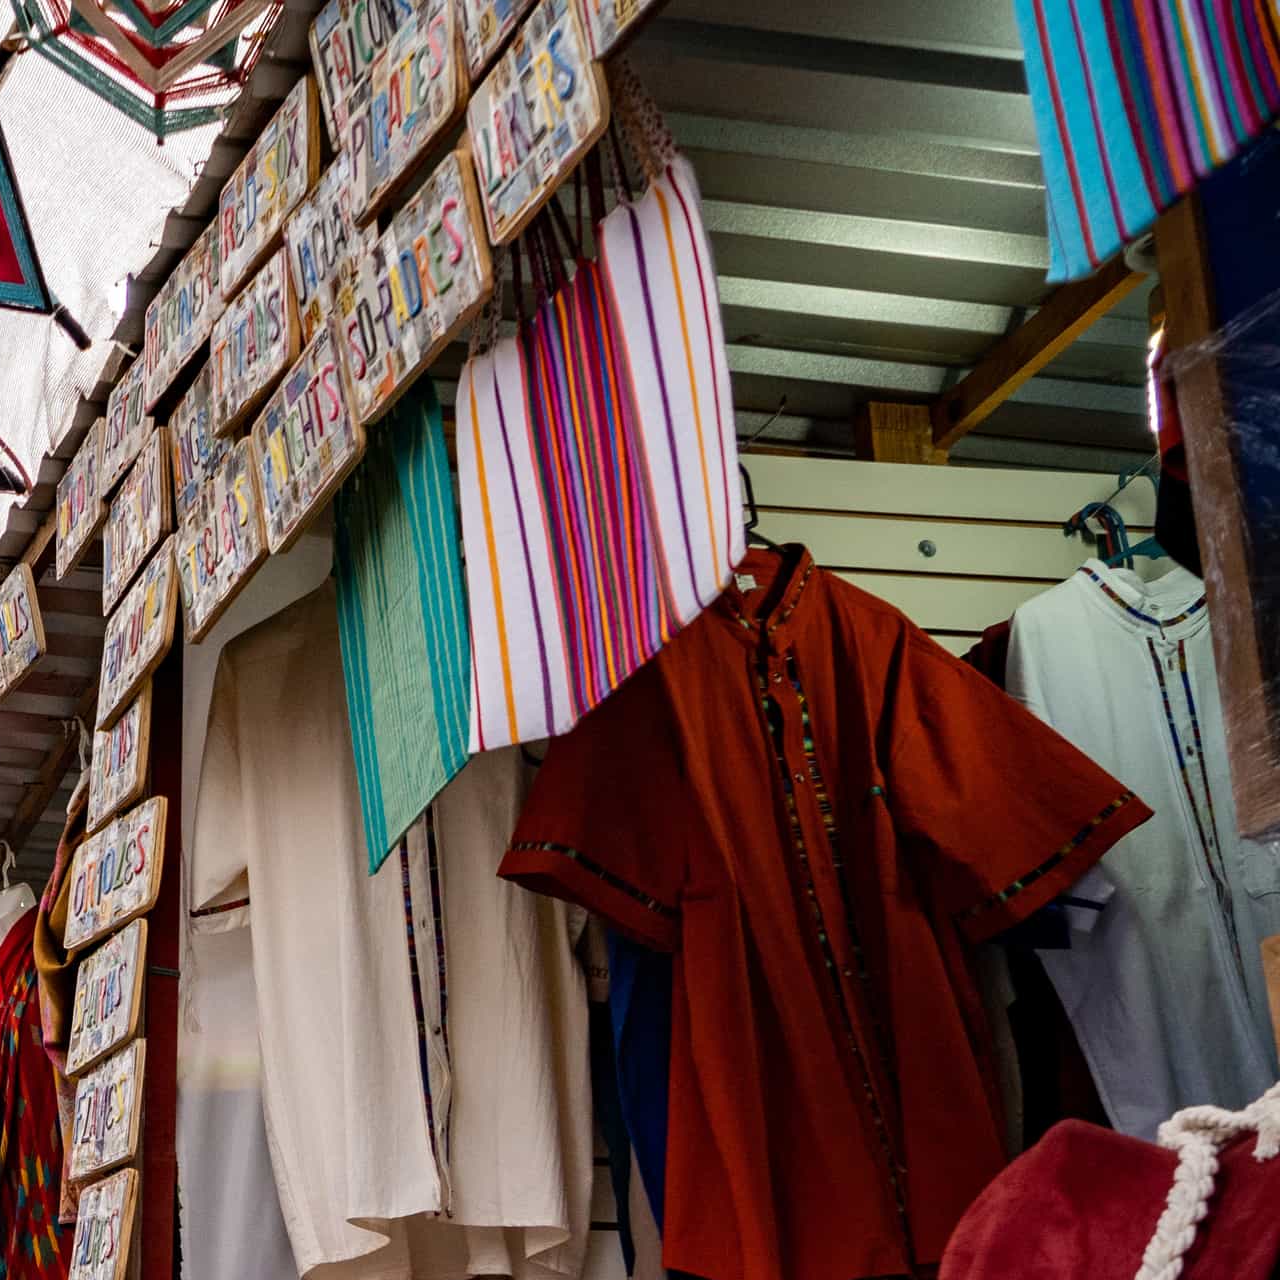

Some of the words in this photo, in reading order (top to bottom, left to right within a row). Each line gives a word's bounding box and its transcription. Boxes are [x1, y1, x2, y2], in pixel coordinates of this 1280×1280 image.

[351, 15, 445, 182] PIRATES
[481, 29, 576, 193] LAKERS
[223, 117, 300, 262] RED-SOX
[297, 185, 351, 305] JAGUAR
[215, 288, 281, 397] TITANS
[348, 197, 464, 381] SD-PADRES
[105, 383, 144, 460] ASTRO
[263, 362, 340, 515] KNIGHTS
[182, 474, 248, 608] STEELERS
[74, 824, 149, 917] ORIOLES
[74, 961, 127, 1034] SHARKS
[74, 1072, 128, 1145] FLAMES
